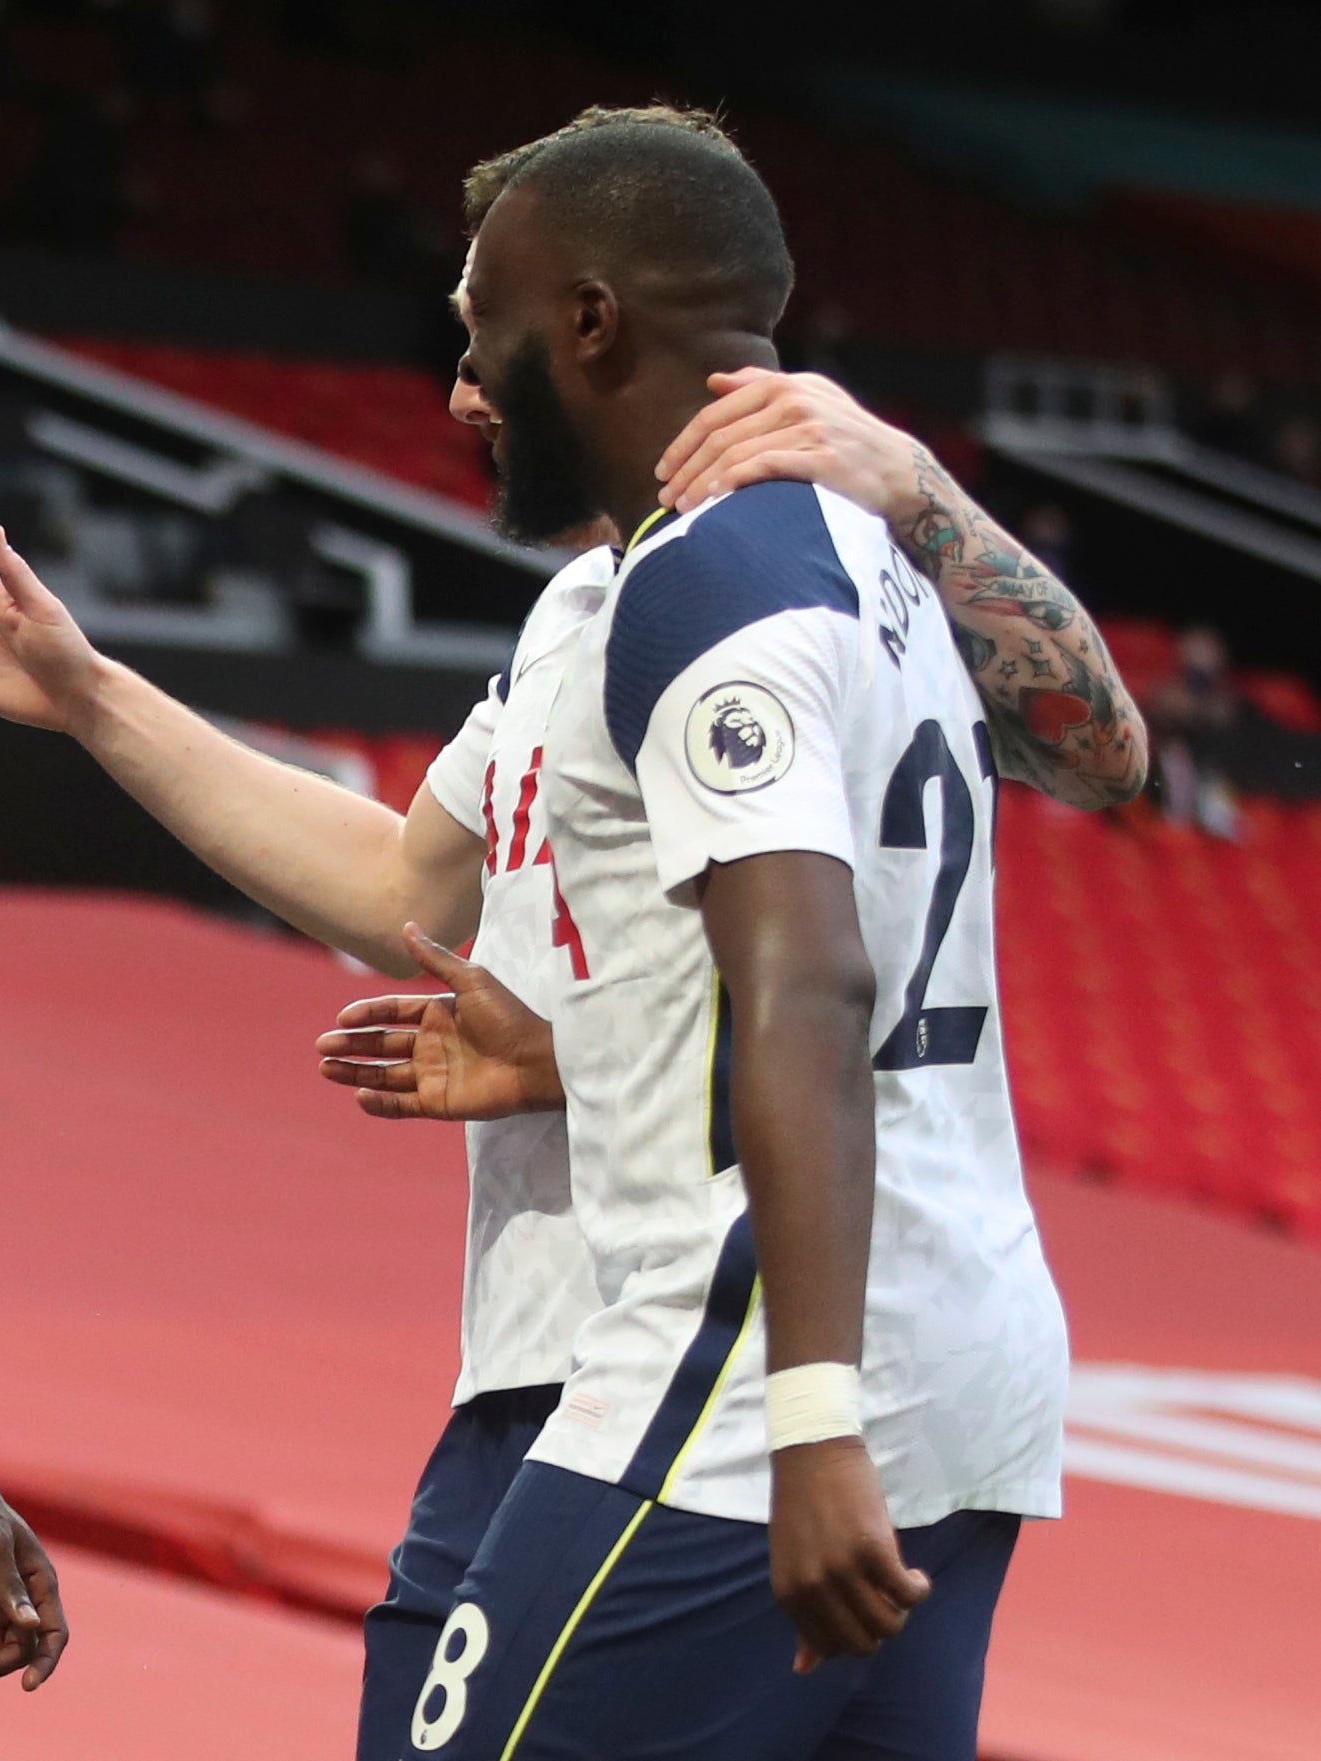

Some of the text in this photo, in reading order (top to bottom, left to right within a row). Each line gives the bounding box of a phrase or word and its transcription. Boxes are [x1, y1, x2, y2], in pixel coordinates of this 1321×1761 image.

[740, 731, 785, 784] Premier League
[872, 718, 999, 1072] 2
[411, 1602, 489, 1750] 8
